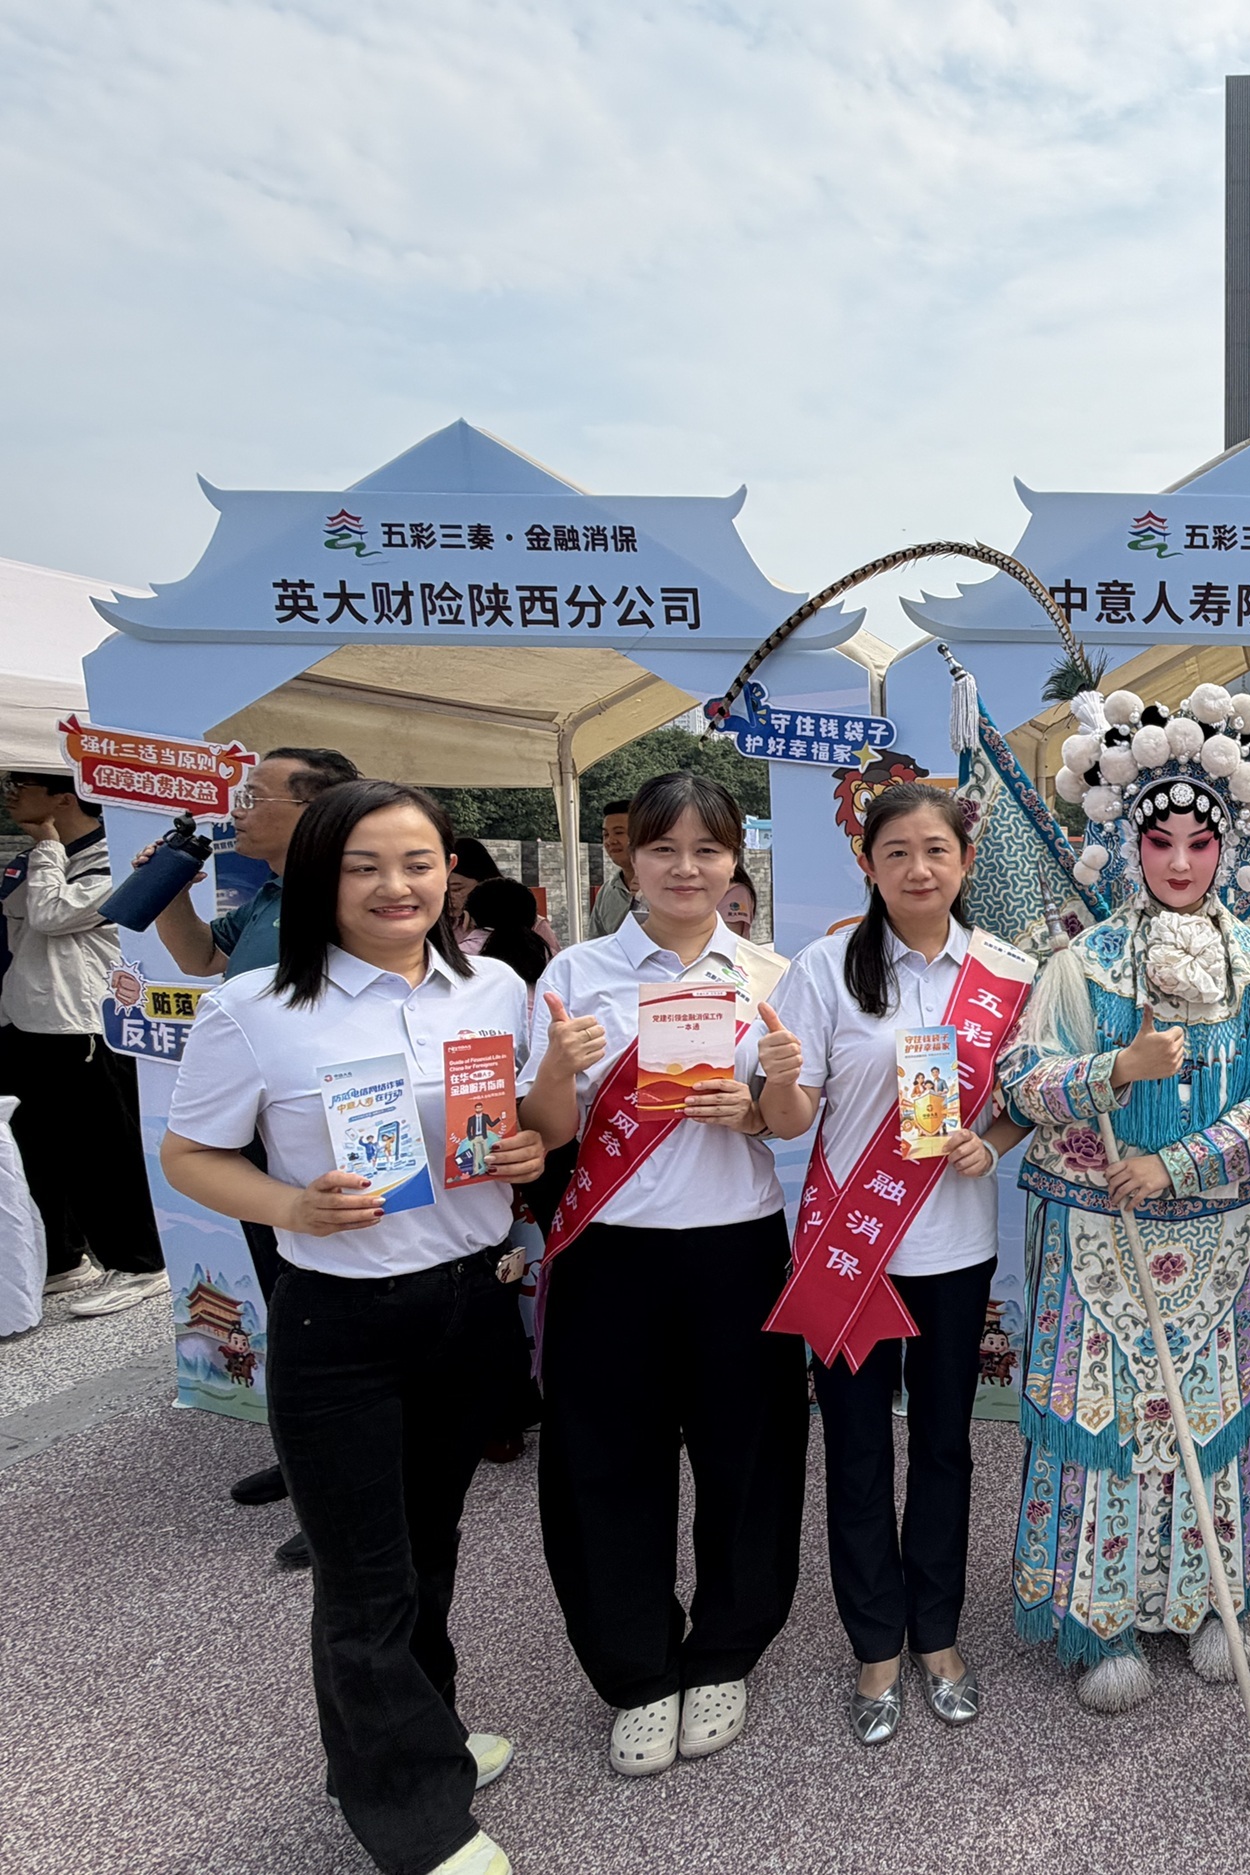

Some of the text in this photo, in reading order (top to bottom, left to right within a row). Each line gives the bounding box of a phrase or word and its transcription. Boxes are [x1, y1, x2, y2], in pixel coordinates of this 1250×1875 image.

[381, 522, 638, 552] 五彩三秦·金融消保
[272, 579, 701, 631] 英大财险陕西分公司
[770, 713, 889, 744] 守住钱袋子
[80, 734, 217, 773] 强化三适当原则
[745, 734, 853, 763] 护好幸福家
[93, 764, 219, 804] 保障消费权益
[152, 992, 202, 1016] 防范
[652, 1013, 723, 1022] 党建引领金融消保工作
[677, 1023, 700, 1031] 一本通
